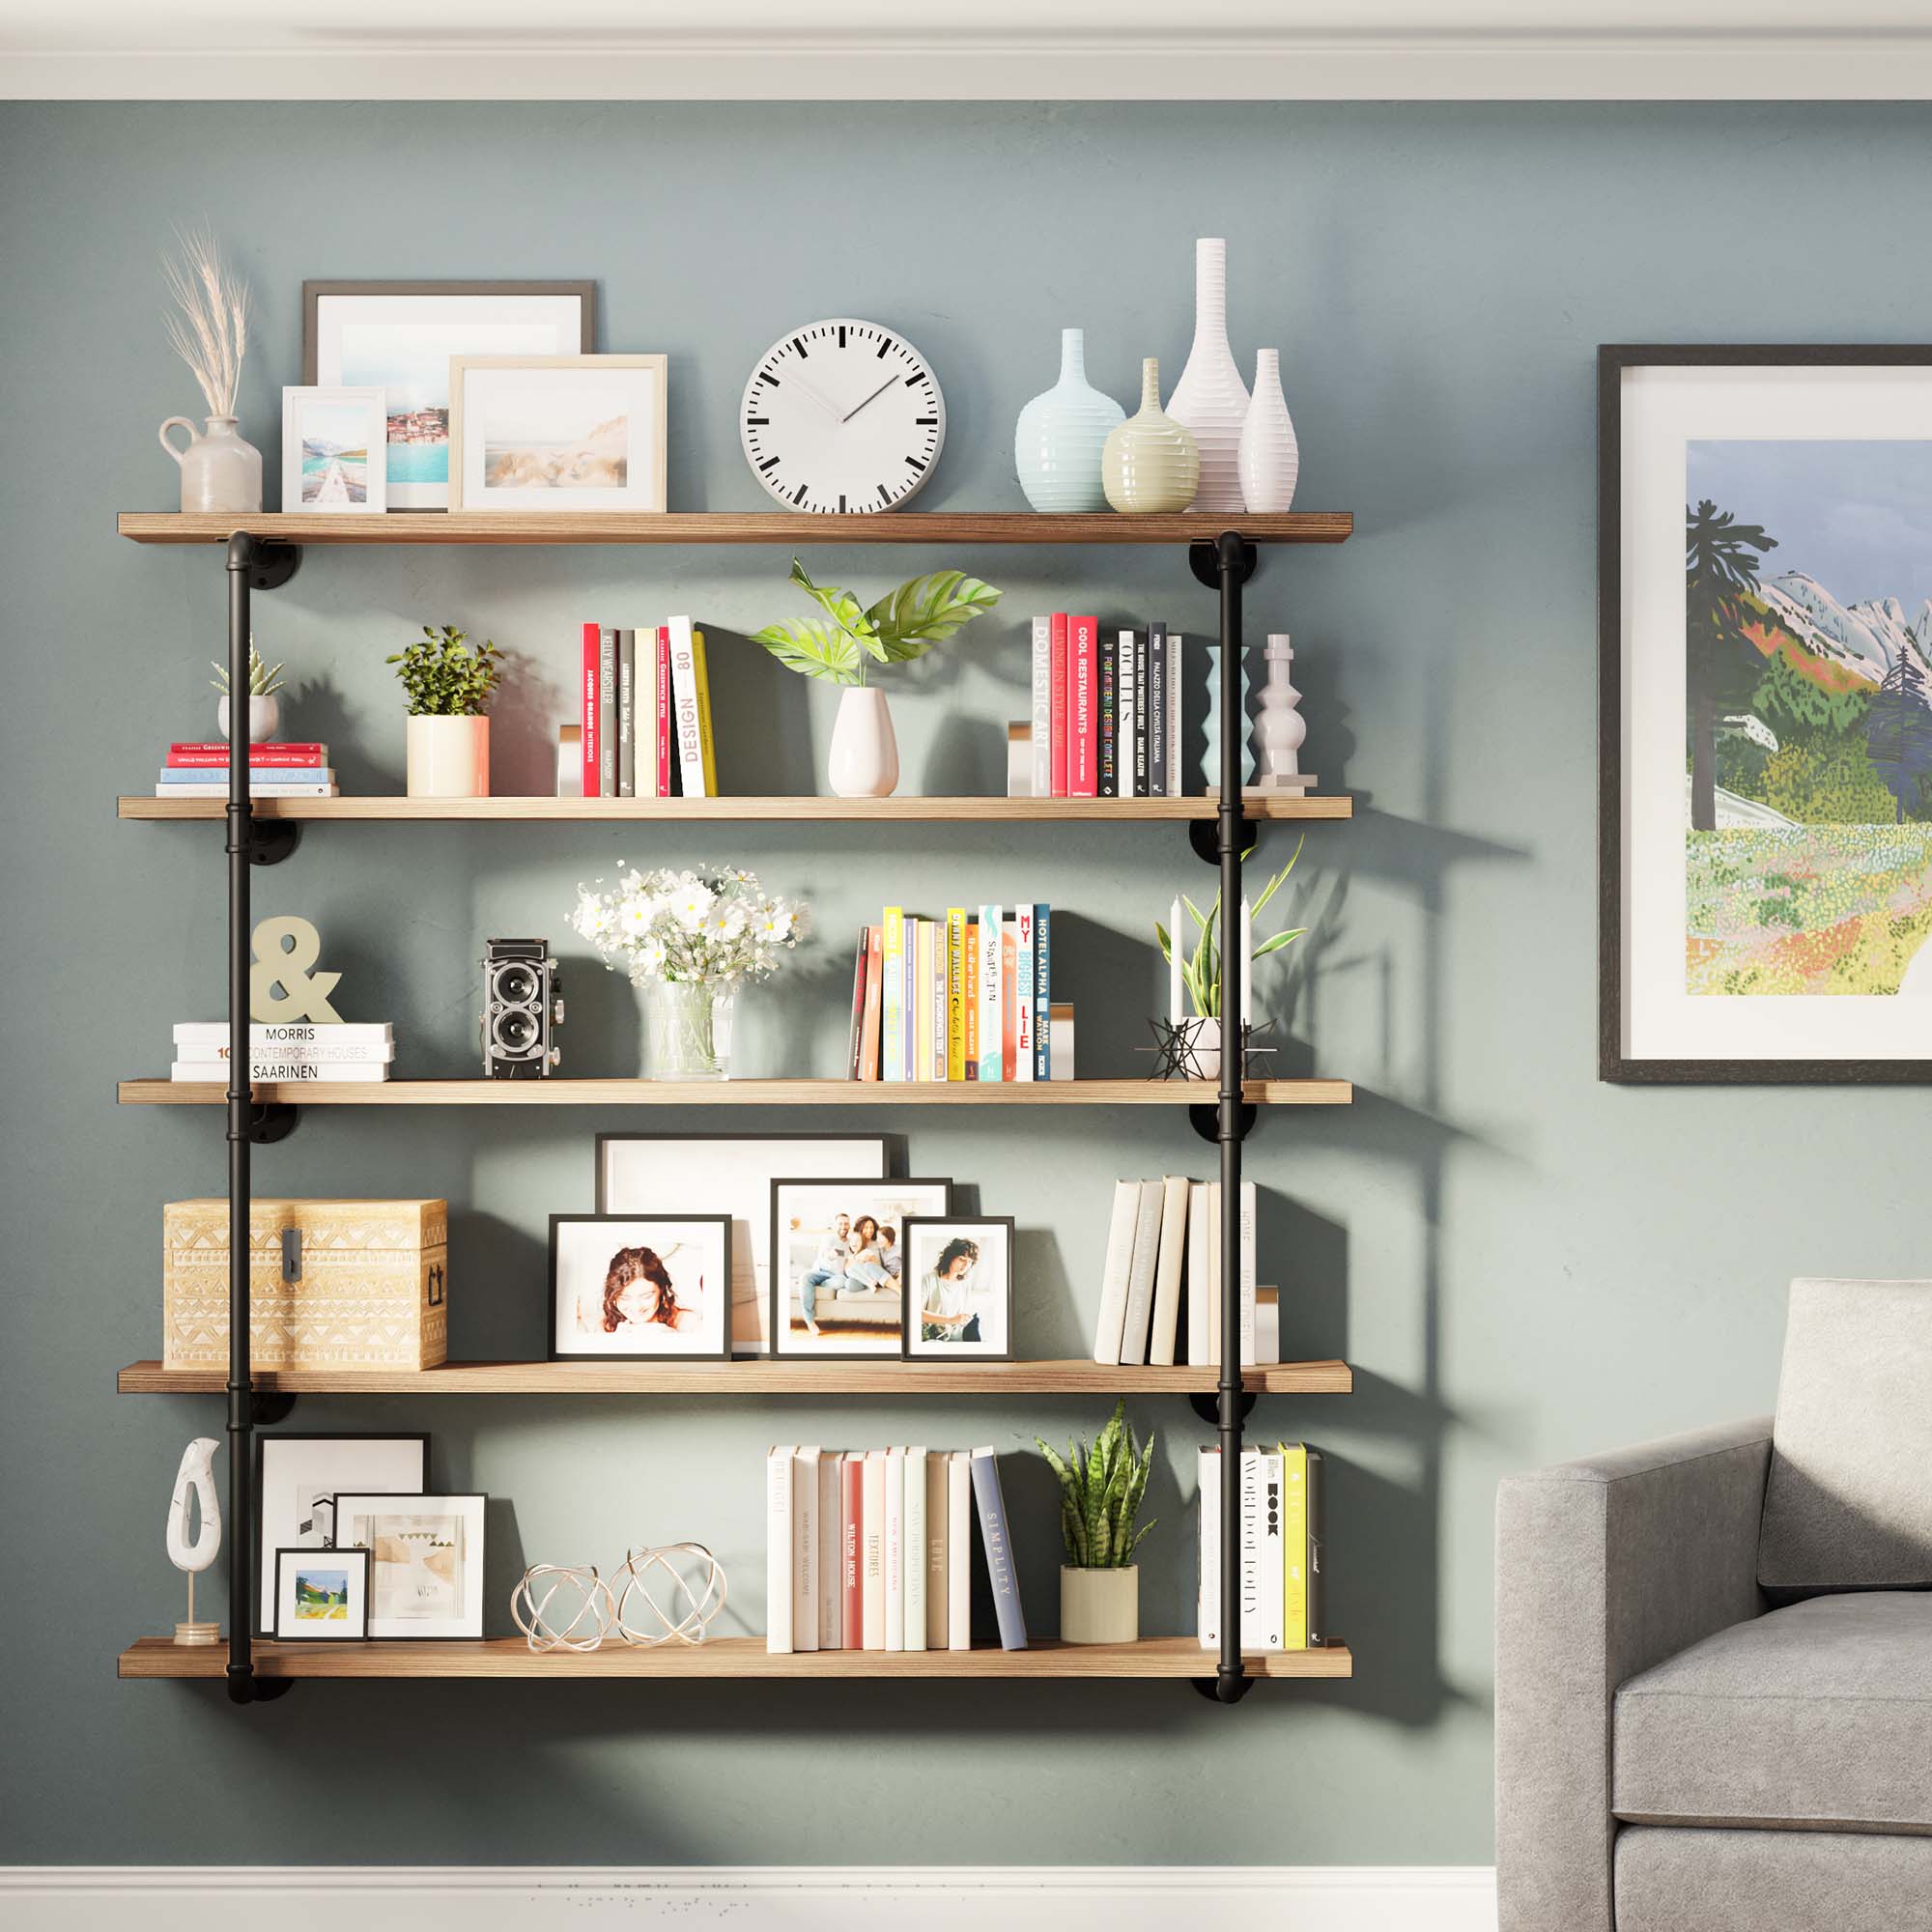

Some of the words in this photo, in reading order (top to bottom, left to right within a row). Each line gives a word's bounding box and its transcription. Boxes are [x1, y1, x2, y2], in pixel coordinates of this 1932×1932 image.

[603, 635, 613, 657] KELLY
[1077, 627, 1088, 654] COOL
[676, 651, 690, 669] 80
[1035, 626, 1049, 715] DOMESTIC
[603, 658, 613, 703] WEARSTLER
[1077, 658, 1088, 734] RESTAURANTS
[1104, 656, 1113, 707] POSTMODERN
[680, 698, 698, 763] DESIGN
[1035, 721, 1049, 751] ART
[1104, 709, 1113, 737] DESIGN
[1104, 739, 1113, 779] COMPLETE
[1020, 916, 1031, 943] MY
[1037, 919, 1047, 954] HOTEL
[1018, 952, 1032, 997] BIGGEST
[1037, 956, 1047, 994] ALPHA
[266, 1028, 315, 1040] MORRIS
[1020, 1006, 1029, 1049] LIE
[253, 1065, 318, 1078] SAARINEN
[1267, 1483, 1278, 1537] BOOK
[847, 1522, 856, 1556] WILTON
[868, 1534, 879, 1577] TEXTURES
[847, 1560, 856, 1588] HOUSE
